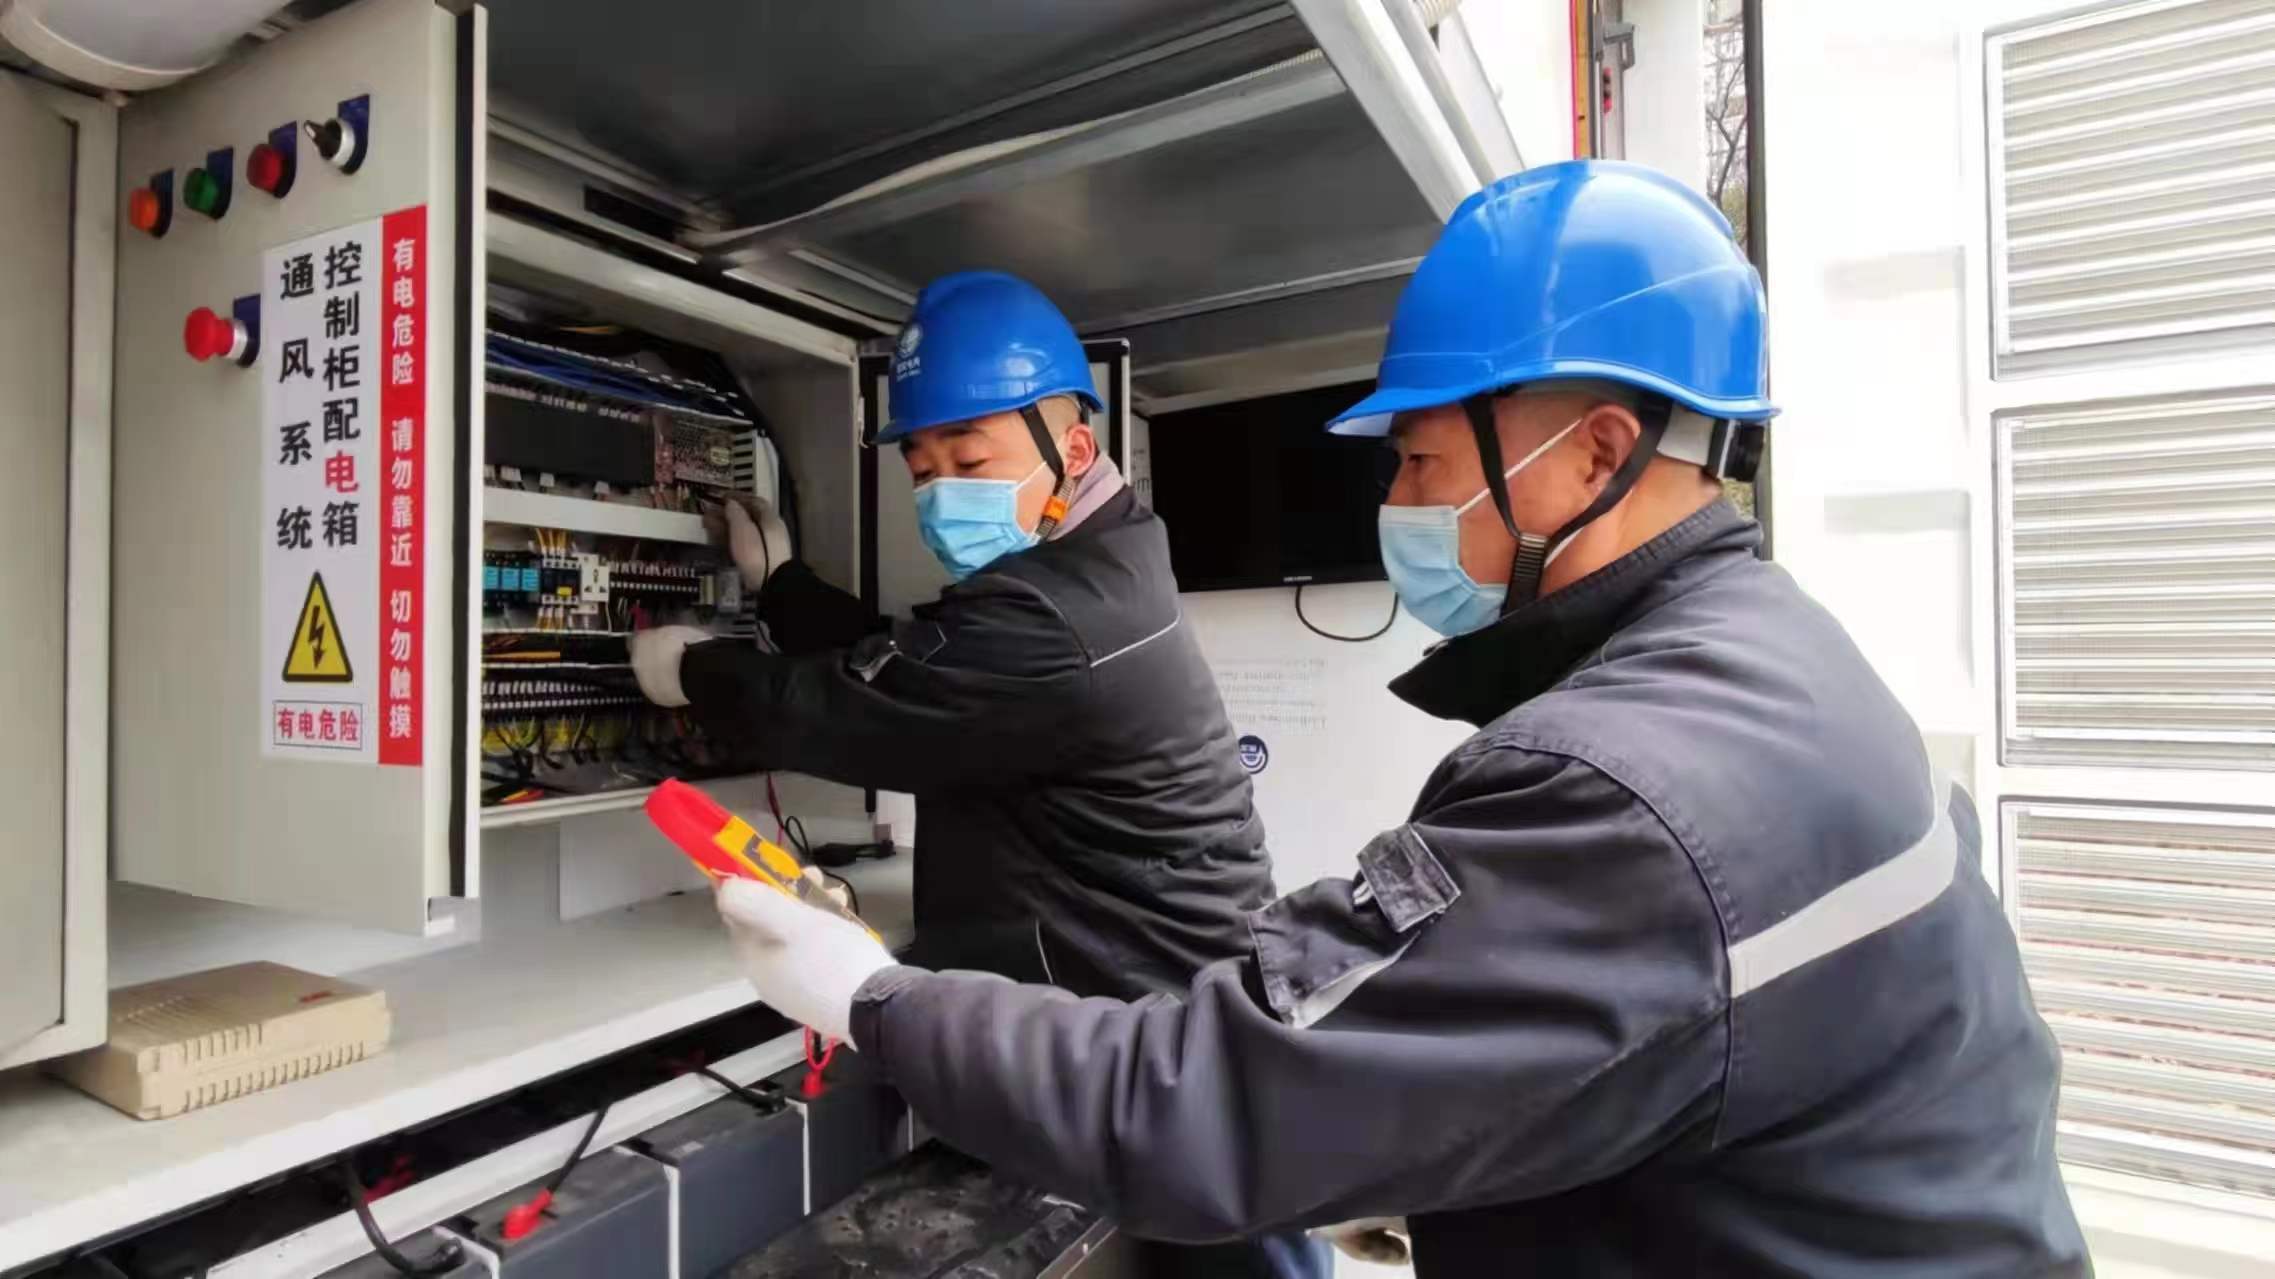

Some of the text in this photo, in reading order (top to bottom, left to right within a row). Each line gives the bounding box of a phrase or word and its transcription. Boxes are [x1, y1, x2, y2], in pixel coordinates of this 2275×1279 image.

[276, 252, 314, 549] 通风系统
[322, 240, 362, 548] 控制柜配电箱
[389, 237, 416, 740] 有电危险 请勿靠近 切勿触摸
[277, 706, 359, 742] 有电危险
